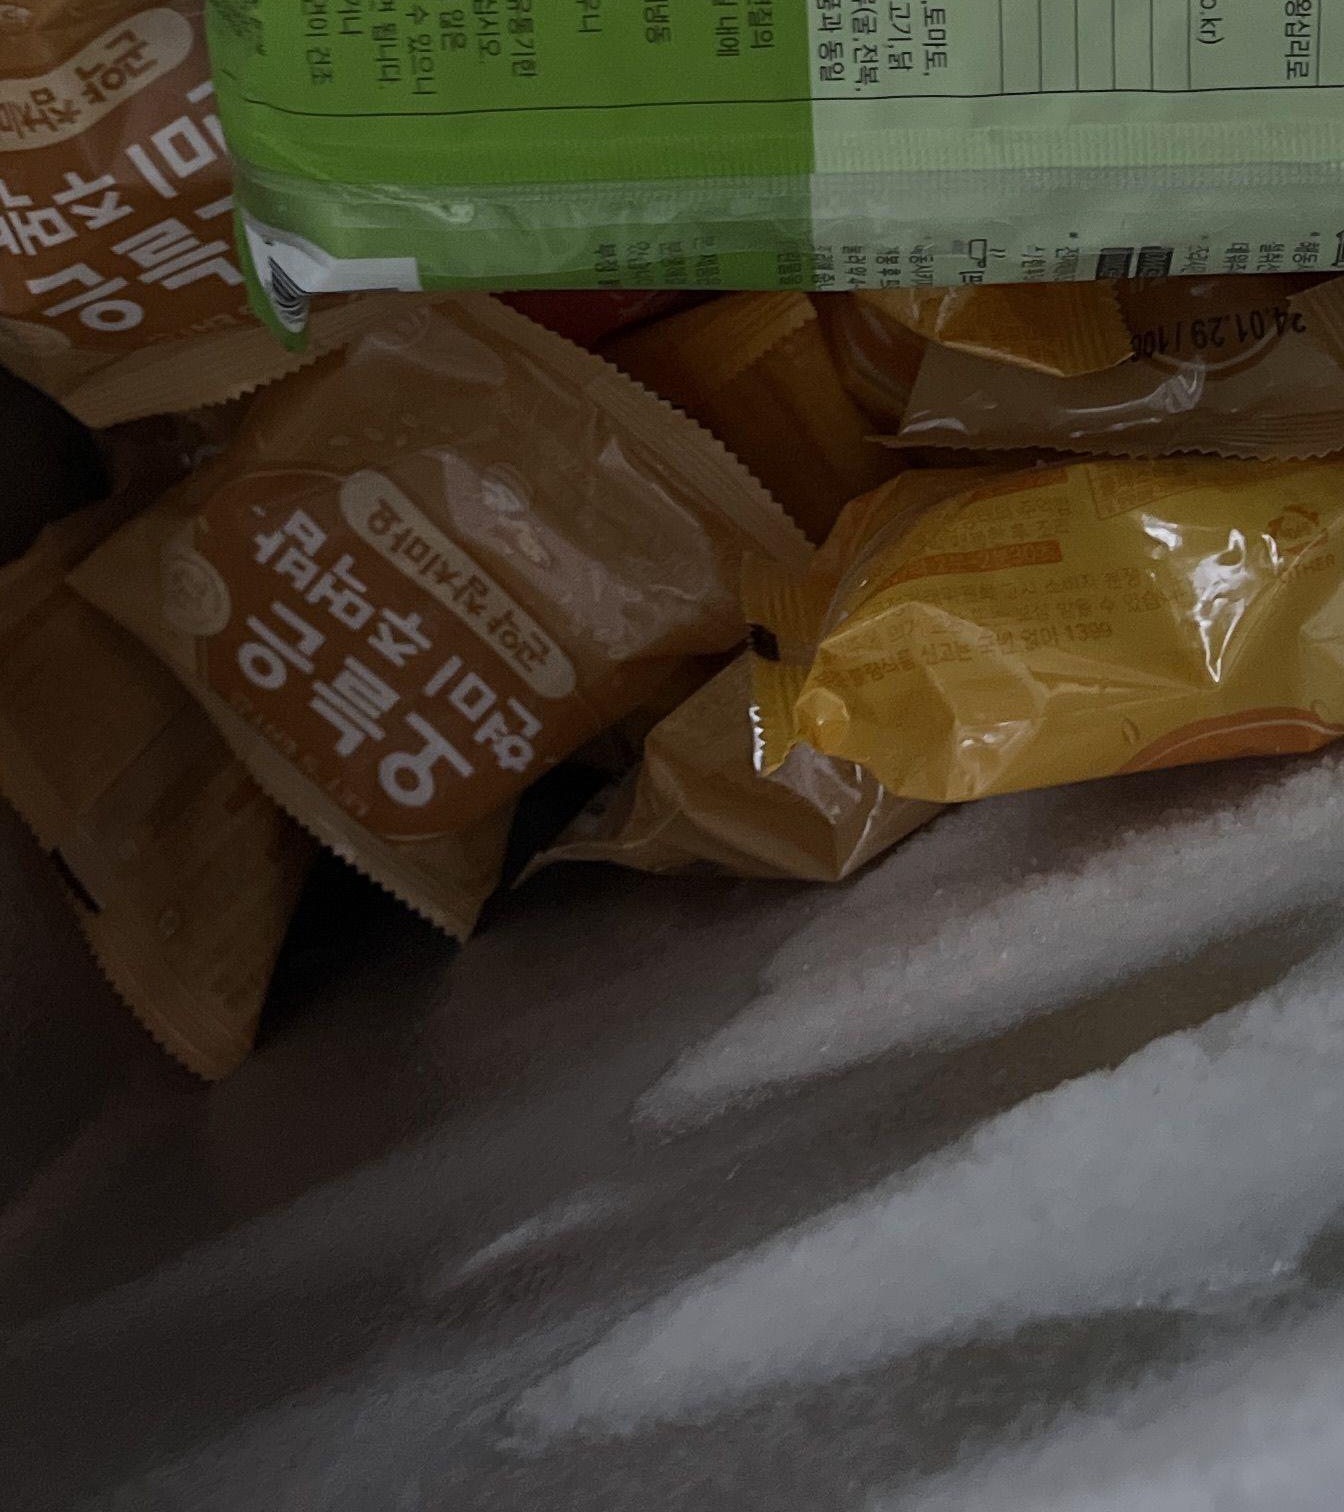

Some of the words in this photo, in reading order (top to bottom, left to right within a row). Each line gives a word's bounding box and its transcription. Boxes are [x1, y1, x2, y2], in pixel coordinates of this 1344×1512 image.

[405, 6, 430, 24] 수
[715, 16, 741, 57] 내에
[1283, 0, 1312, 80] 왕십리로
[79, 31, 158, 104] 곤약
[407, 34, 436, 95] 있으니
[818, 41, 845, 83] 동일
[26, 197, 244, 333] 늘은
[254, 509, 434, 668] 주먹밥
[366, 498, 488, 619] 참치마요
[487, 614, 554, 675] 곤약
[236, 599, 475, 807] 오늘은
[424, 653, 544, 772] 현미
